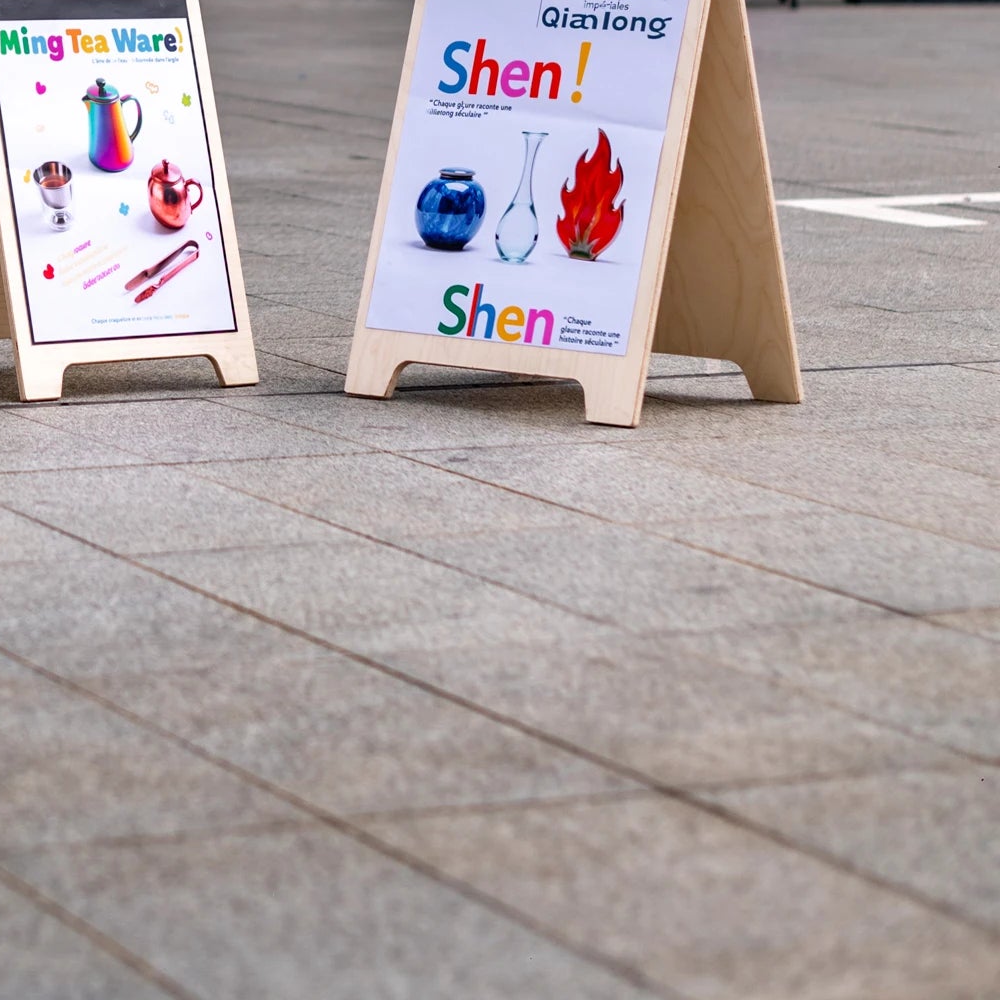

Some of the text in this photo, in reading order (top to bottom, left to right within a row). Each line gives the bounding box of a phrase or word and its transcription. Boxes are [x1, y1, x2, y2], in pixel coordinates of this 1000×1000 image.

[0, 26, 64, 62] Ming
[65, 28, 110, 53] Tea
[438, 38, 562, 100] Shen
[437, 283, 555, 345] Shen
